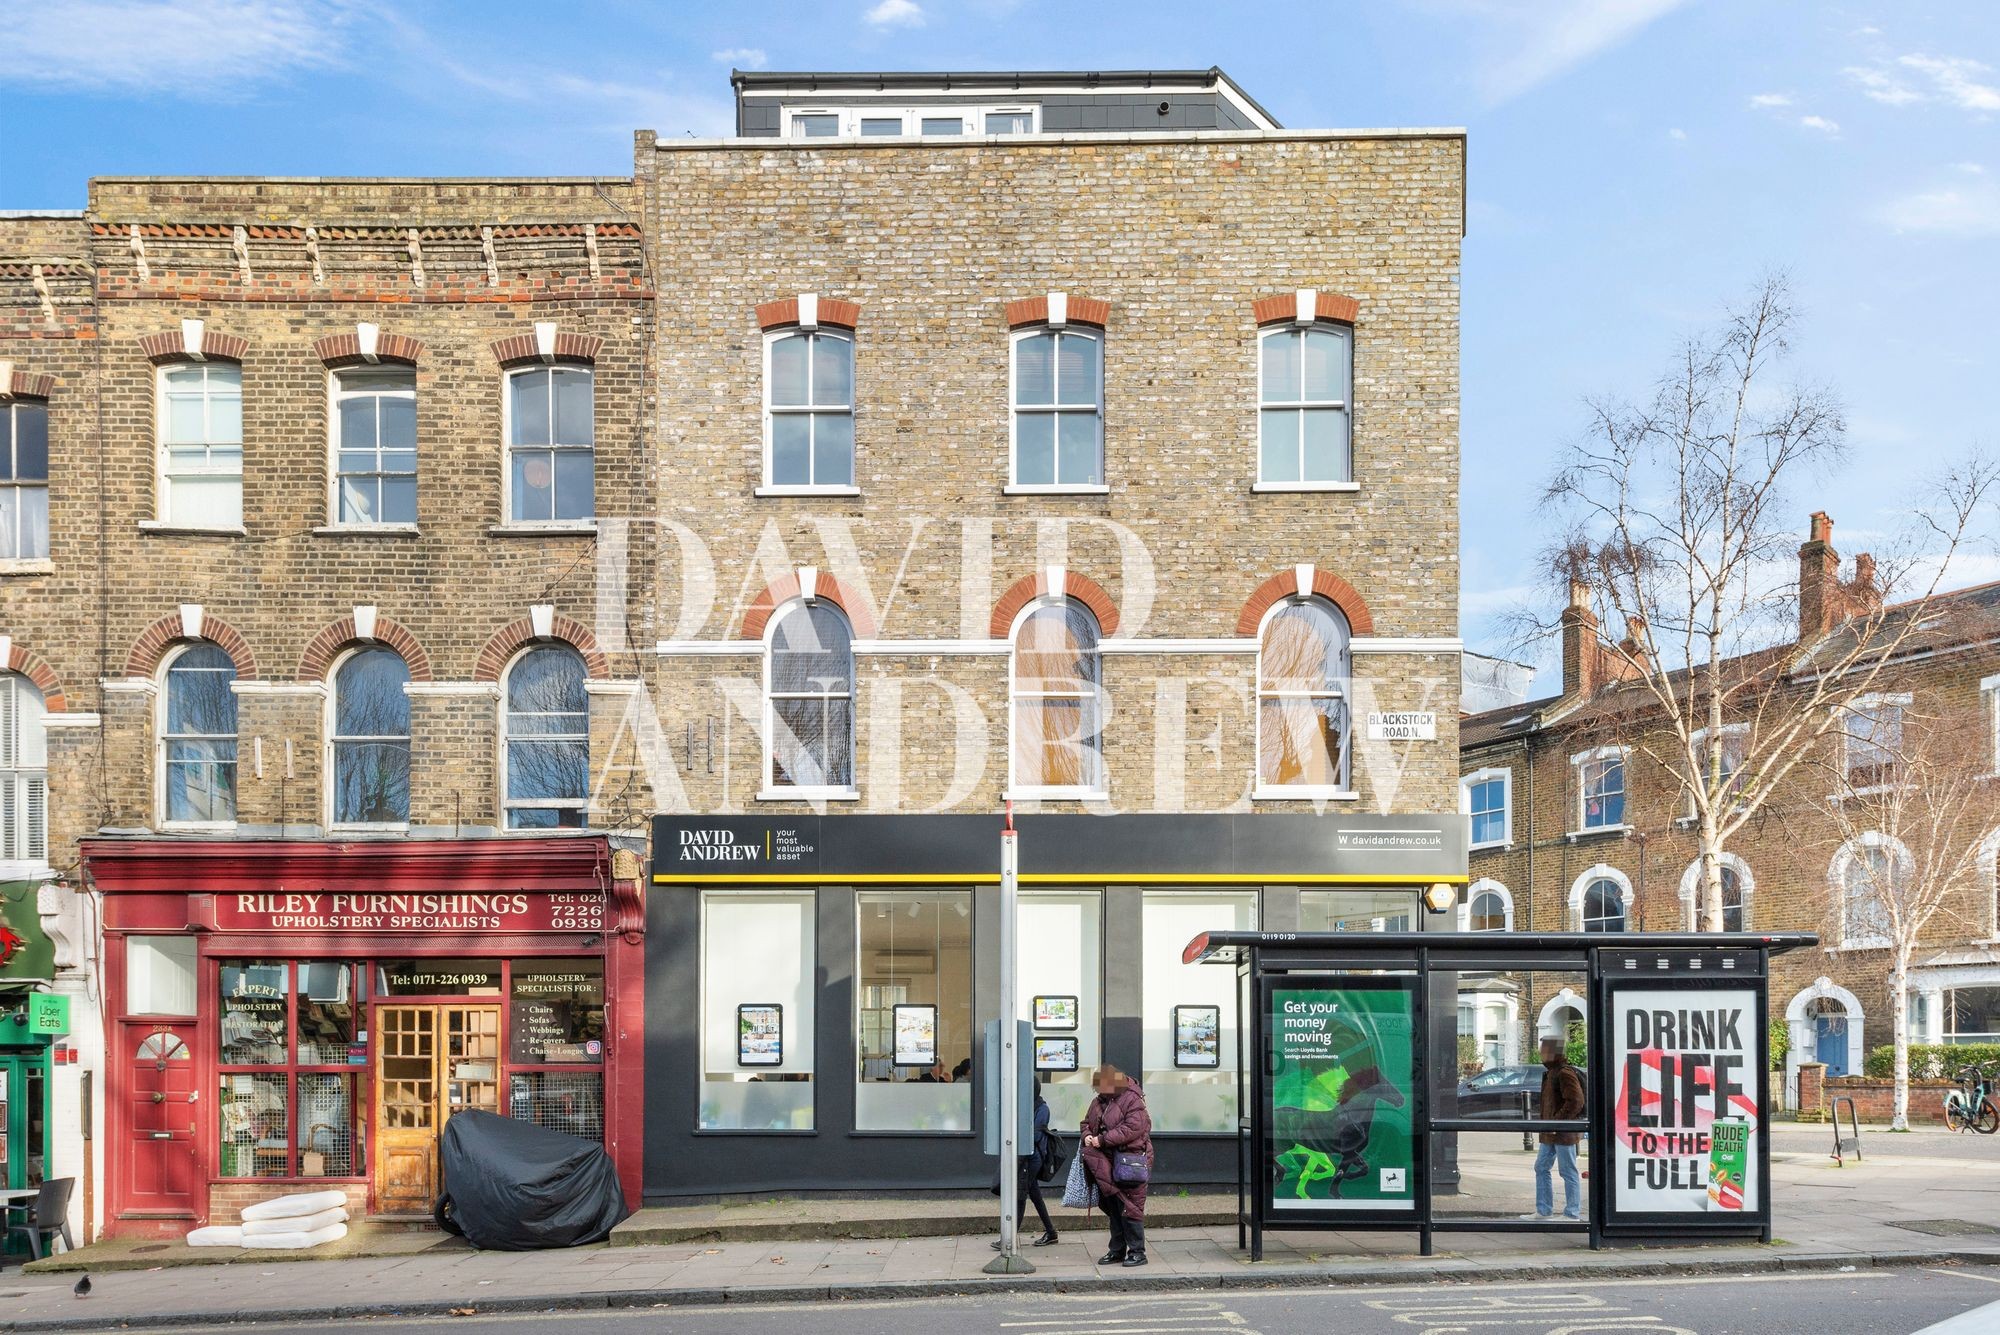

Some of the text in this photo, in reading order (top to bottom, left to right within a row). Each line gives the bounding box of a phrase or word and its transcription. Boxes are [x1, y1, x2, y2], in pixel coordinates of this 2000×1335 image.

[1369, 714, 1433, 725] BLACKSTOCK
[680, 830, 734, 845] DAVID
[776, 829, 796, 837] your
[776, 836, 798, 845] most
[1338, 835, 1441, 845] W davidandrew.co.uk
[679, 845, 761, 861] ANDREW
[776, 845, 814, 853] valuable
[776, 852, 801, 860] asset
[548, 893, 574, 903] Tel:
[237, 894, 529, 914] RILEY FURNISHINGS
[551, 906, 602, 916] 7226
[272, 916, 501, 928] UPHOLSTERY SPECIALISTS
[551, 918, 602, 929] 0939
[391, 974, 488, 985] Tel: 0171-226 0939
[527, 974, 586, 982] UPHOLSTERY
[232, 984, 278, 998] EXPERT
[516, 985, 573, 993] SPECIALISTS
[40, 1006, 61, 1016] Uber
[226, 1003, 282, 1011] UPHOLSTERY
[529, 1006, 553, 1014] Chairs
[1284, 1001, 1338, 1016] Get your
[40, 1017, 61, 1027] Eats
[529, 1016, 550, 1024] Sofas
[1284, 1018, 1326, 1031] money
[152, 1024, 173, 1033] 233A
[529, 1026, 564, 1035] Webbings
[1626, 1008, 1743, 1050] DRINK
[1284, 1031, 1332, 1045] moving
[529, 1047, 584, 1056] Chaise-Longue
[1627, 1053, 1745, 1129] LIFE
[1714, 1126, 1744, 1141] RUDE
[1627, 1132, 1709, 1154] TO THE
[1713, 1141, 1743, 1152] HEALTH
[1628, 1158, 1708, 1190] FULL
